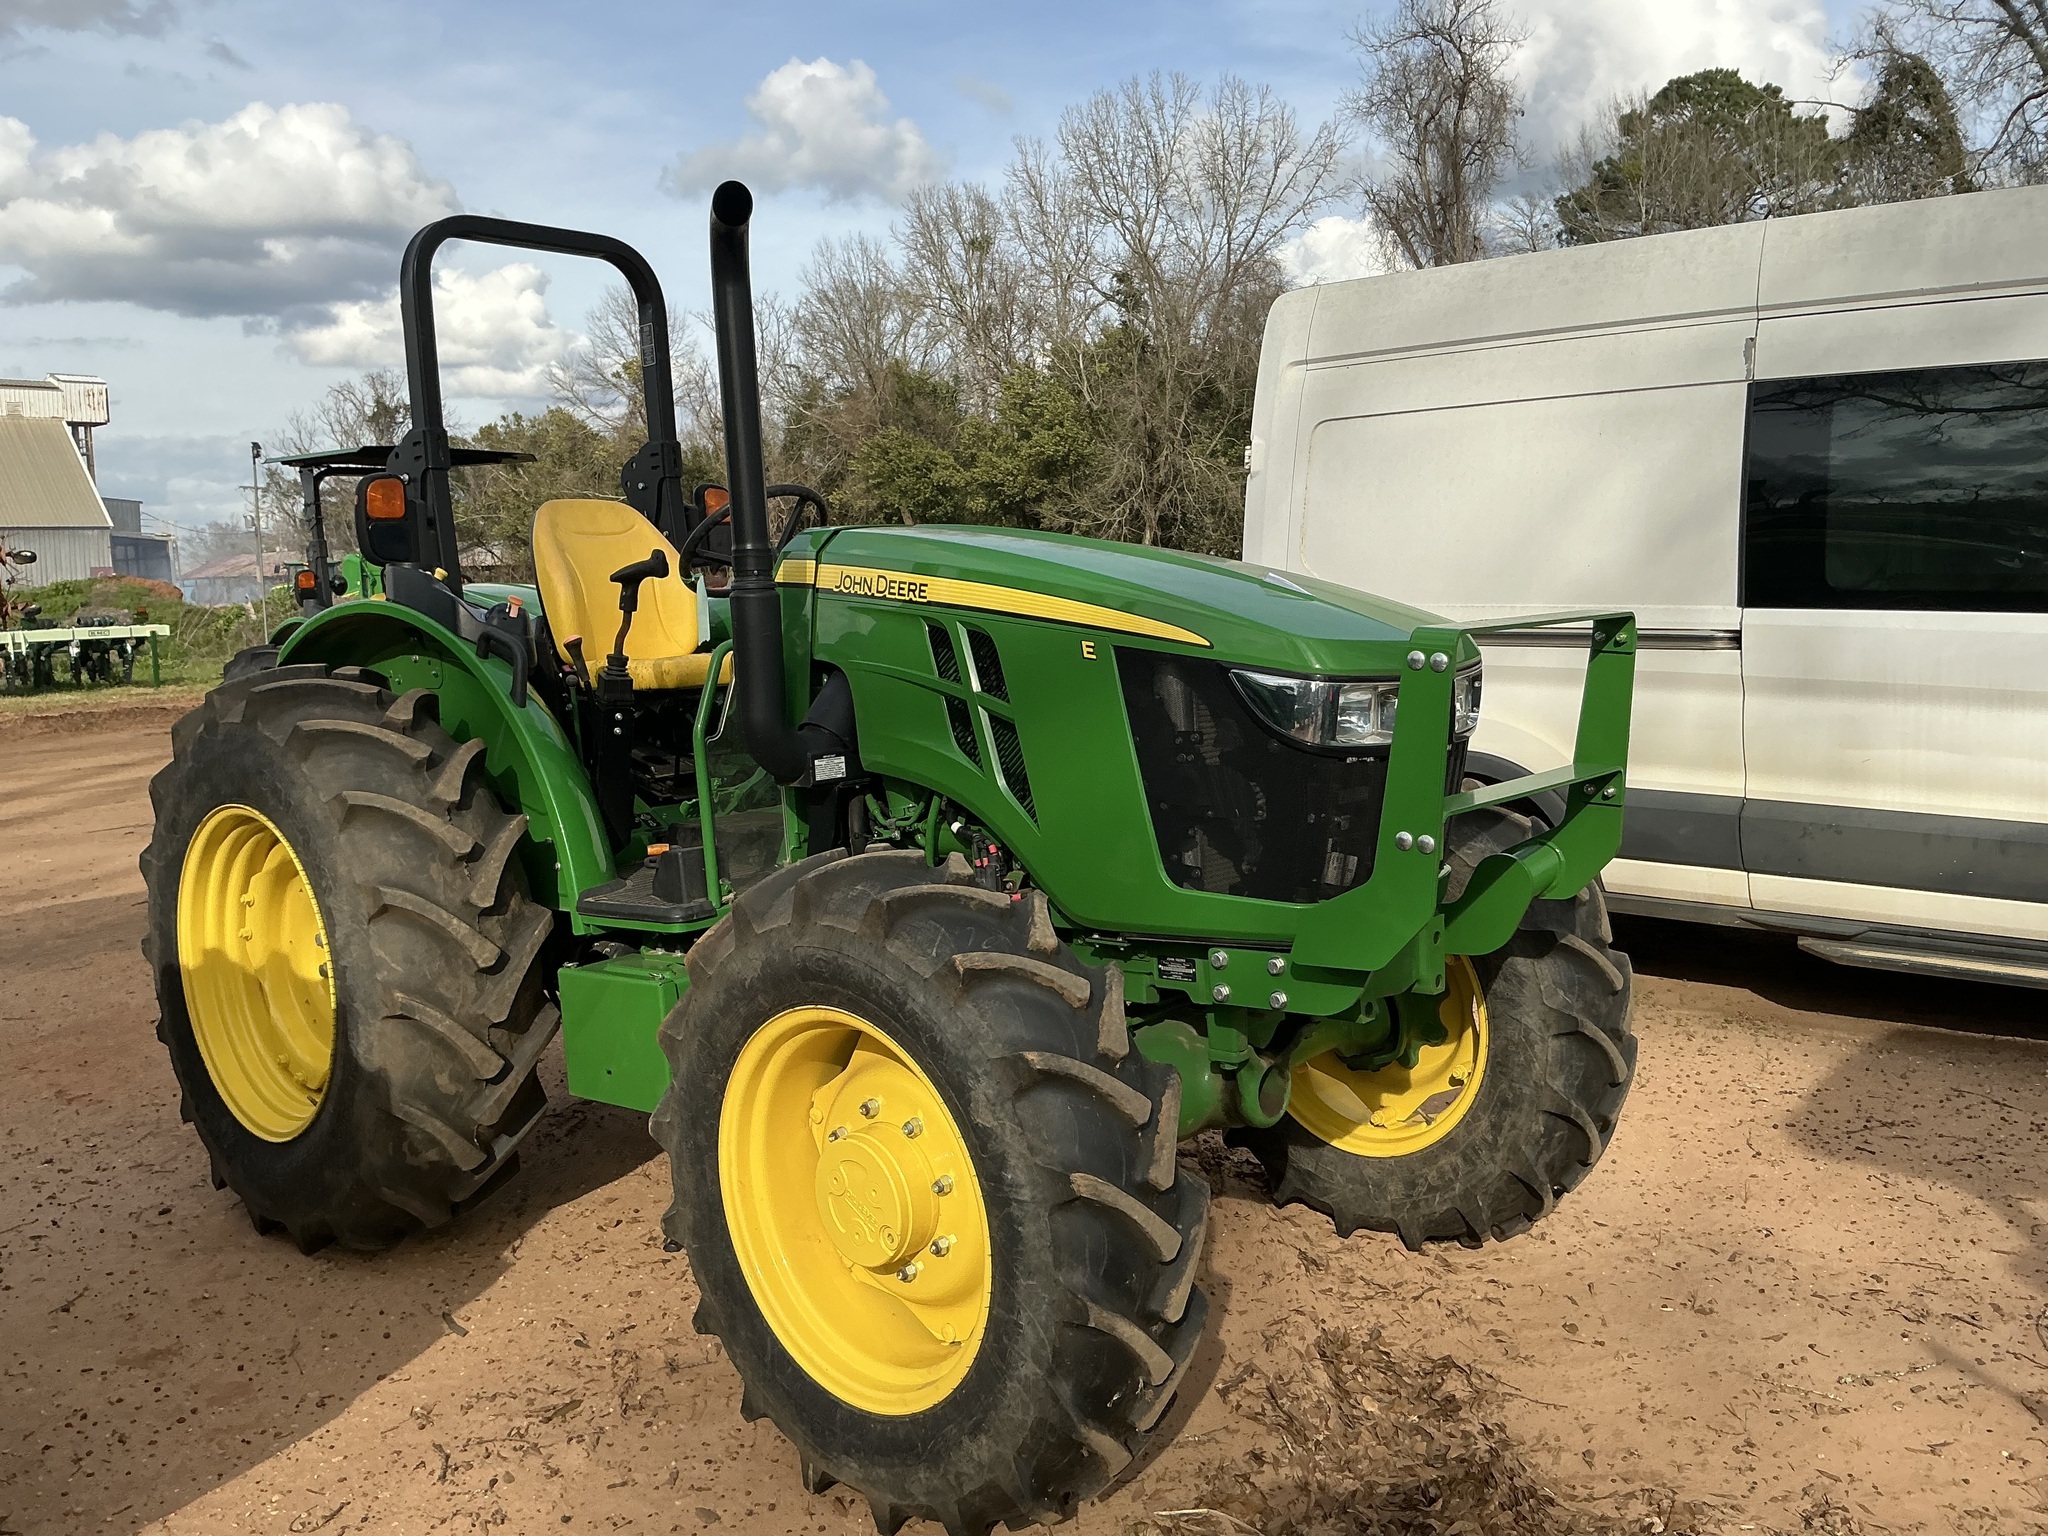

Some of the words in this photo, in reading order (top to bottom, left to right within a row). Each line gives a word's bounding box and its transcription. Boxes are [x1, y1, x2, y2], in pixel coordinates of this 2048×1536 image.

[834, 570, 873, 594] JOHN
[876, 575, 928, 599] DEERE
[1081, 640, 1097, 660] E
